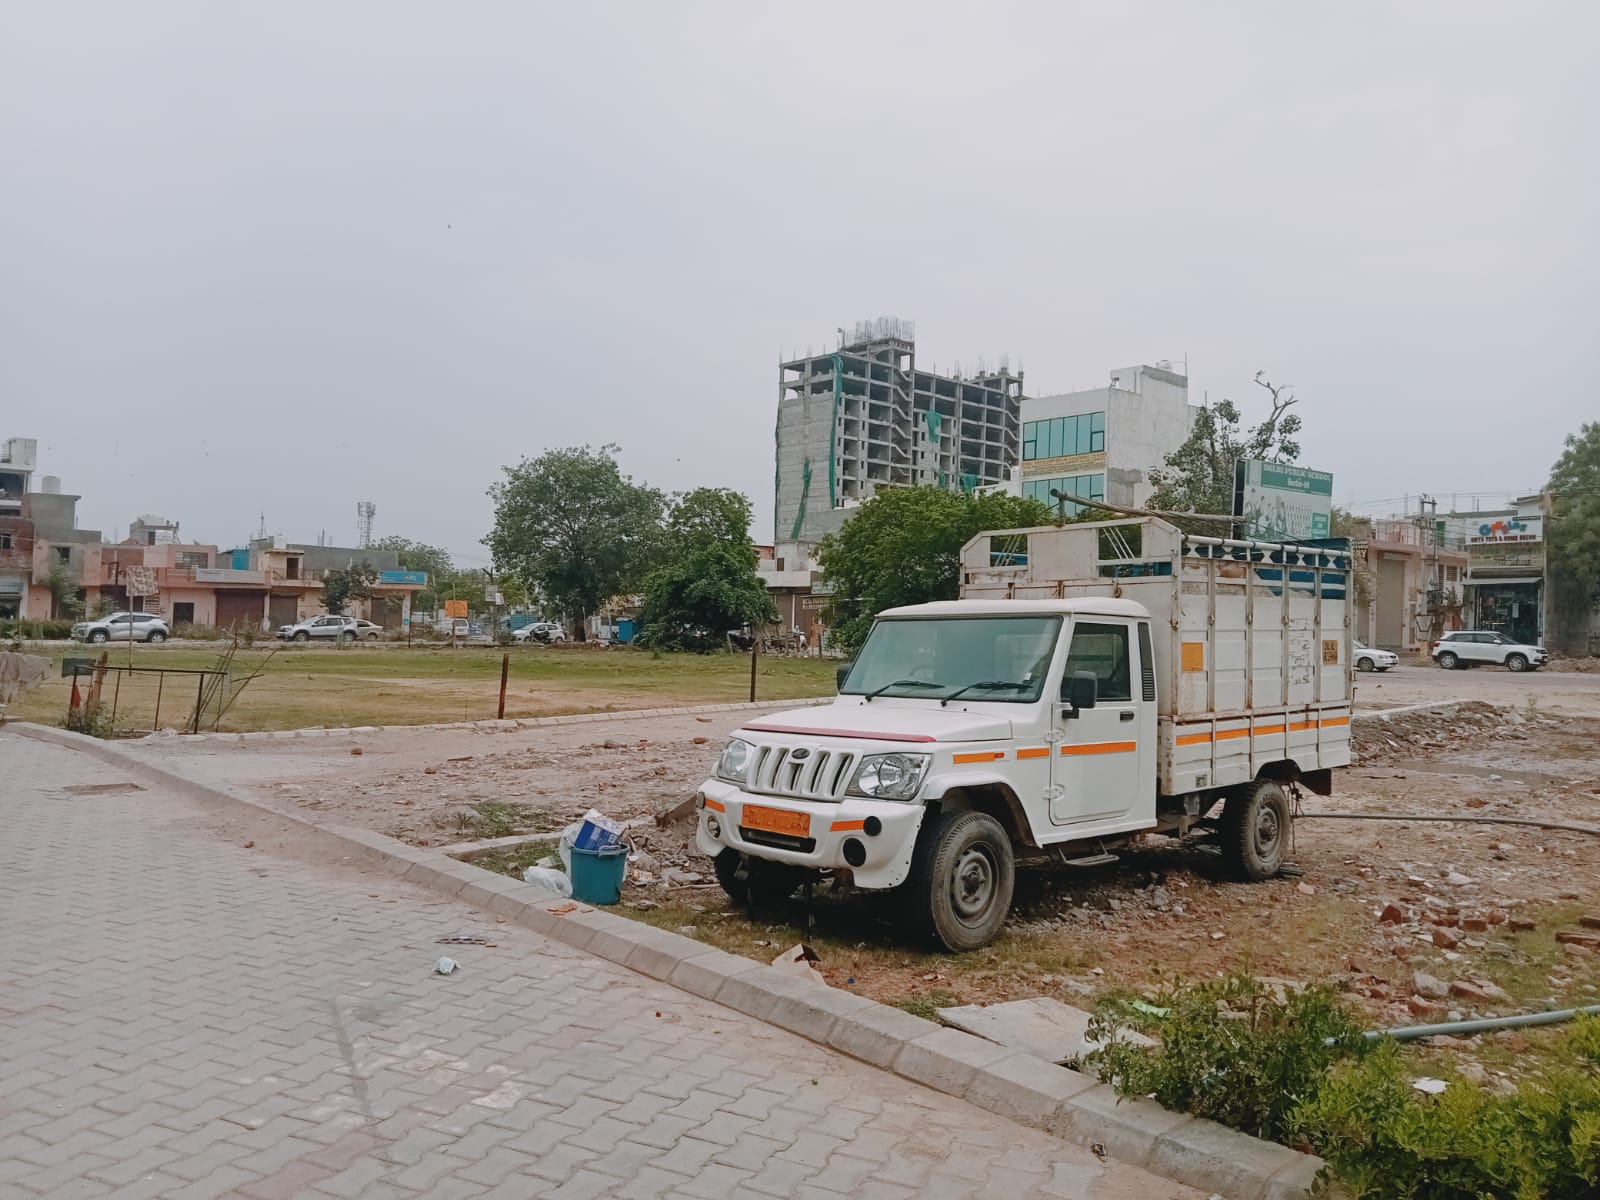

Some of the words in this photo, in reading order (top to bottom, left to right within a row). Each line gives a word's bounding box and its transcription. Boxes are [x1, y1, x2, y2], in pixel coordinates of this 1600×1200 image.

[1263, 463, 1283, 473] DELHI
[1284, 467, 1307, 478] PUBLIC
[1307, 471, 1332, 481] SCHOOL
